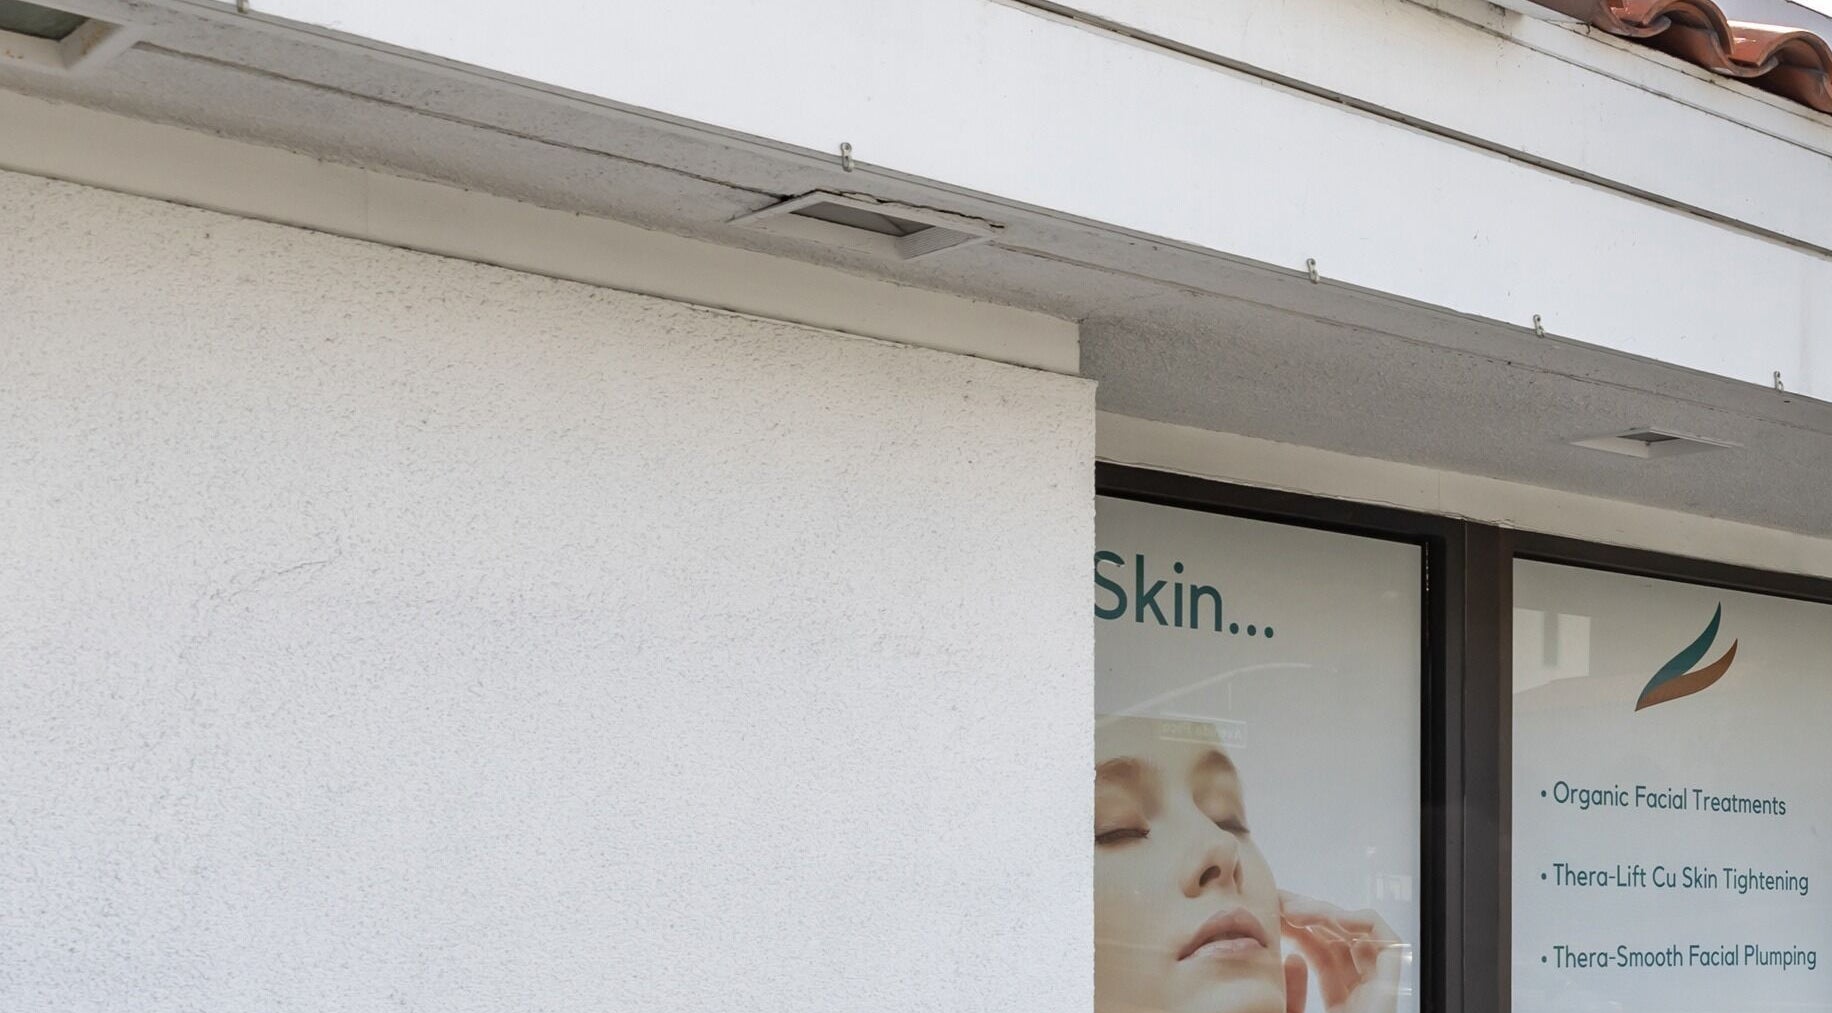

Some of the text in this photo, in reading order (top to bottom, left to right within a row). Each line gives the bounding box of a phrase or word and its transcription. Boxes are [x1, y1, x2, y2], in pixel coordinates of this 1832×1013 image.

[1094, 550, 1274, 639] Skin...
[1553, 780, 1787, 816] Organic Facial Treatments
[1553, 863, 1809, 896] Thera-Lift Cu Skin Tightening
[1553, 945, 1817, 970] Thera-Smooth Facial Plumping
